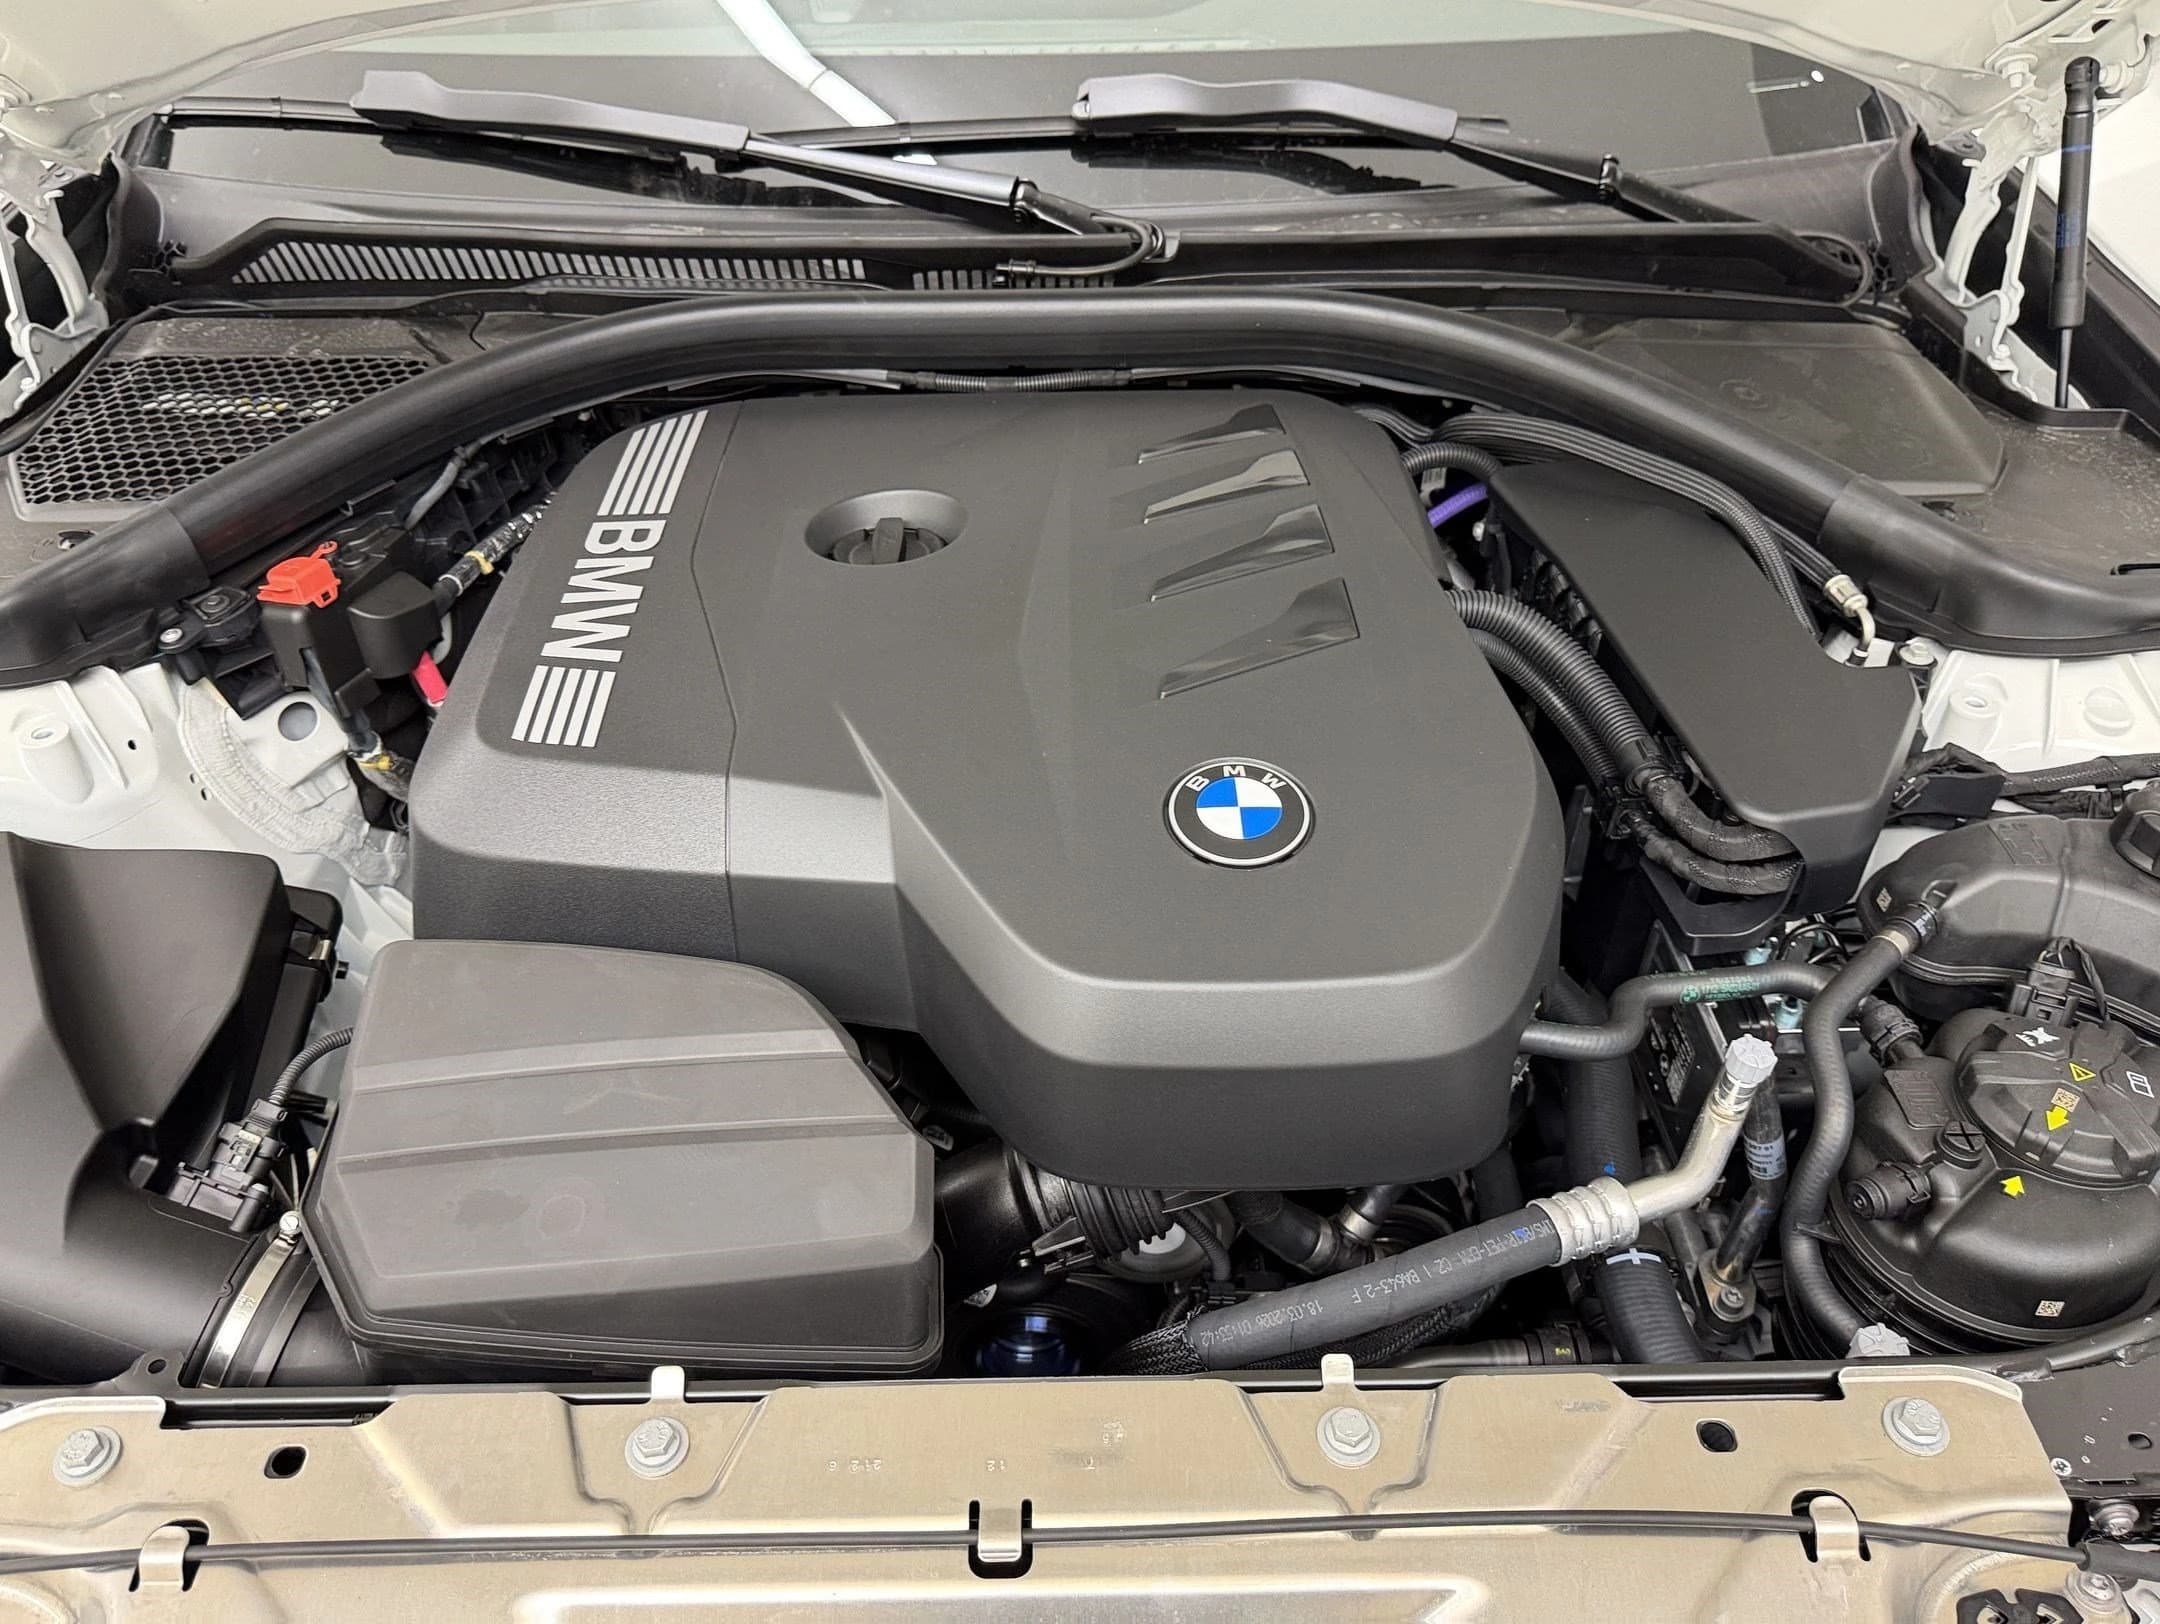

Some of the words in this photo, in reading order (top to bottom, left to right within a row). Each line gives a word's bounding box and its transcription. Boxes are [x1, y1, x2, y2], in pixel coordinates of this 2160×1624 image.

[540, 519, 667, 663] BMW
[1185, 765, 1287, 792] BMW
[1351, 1289, 1363, 1305] F
